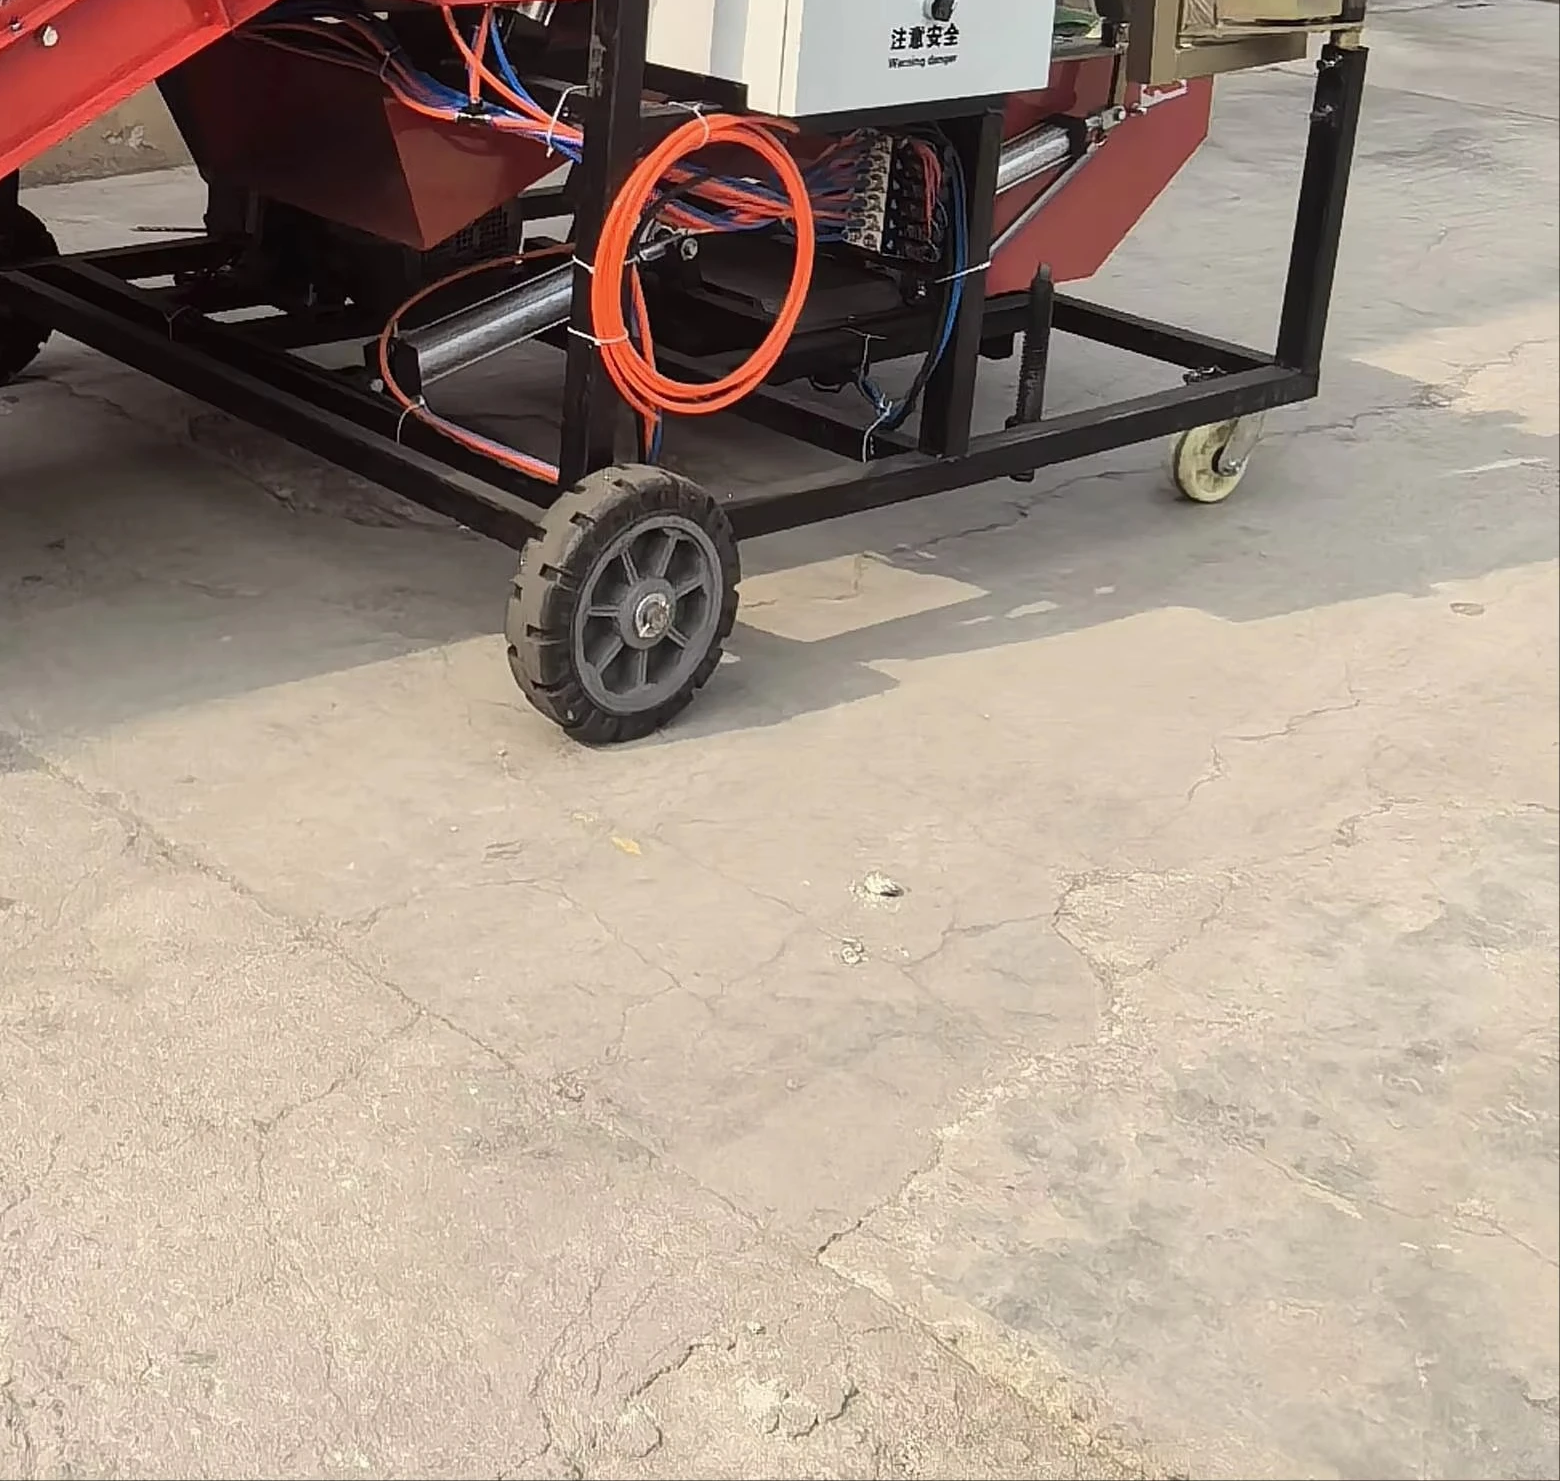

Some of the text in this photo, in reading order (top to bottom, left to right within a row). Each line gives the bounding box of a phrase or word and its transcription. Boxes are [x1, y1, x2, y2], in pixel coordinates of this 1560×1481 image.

[890, 23, 960, 50] 注意安全
[888, 55, 958, 69] Warning danger
